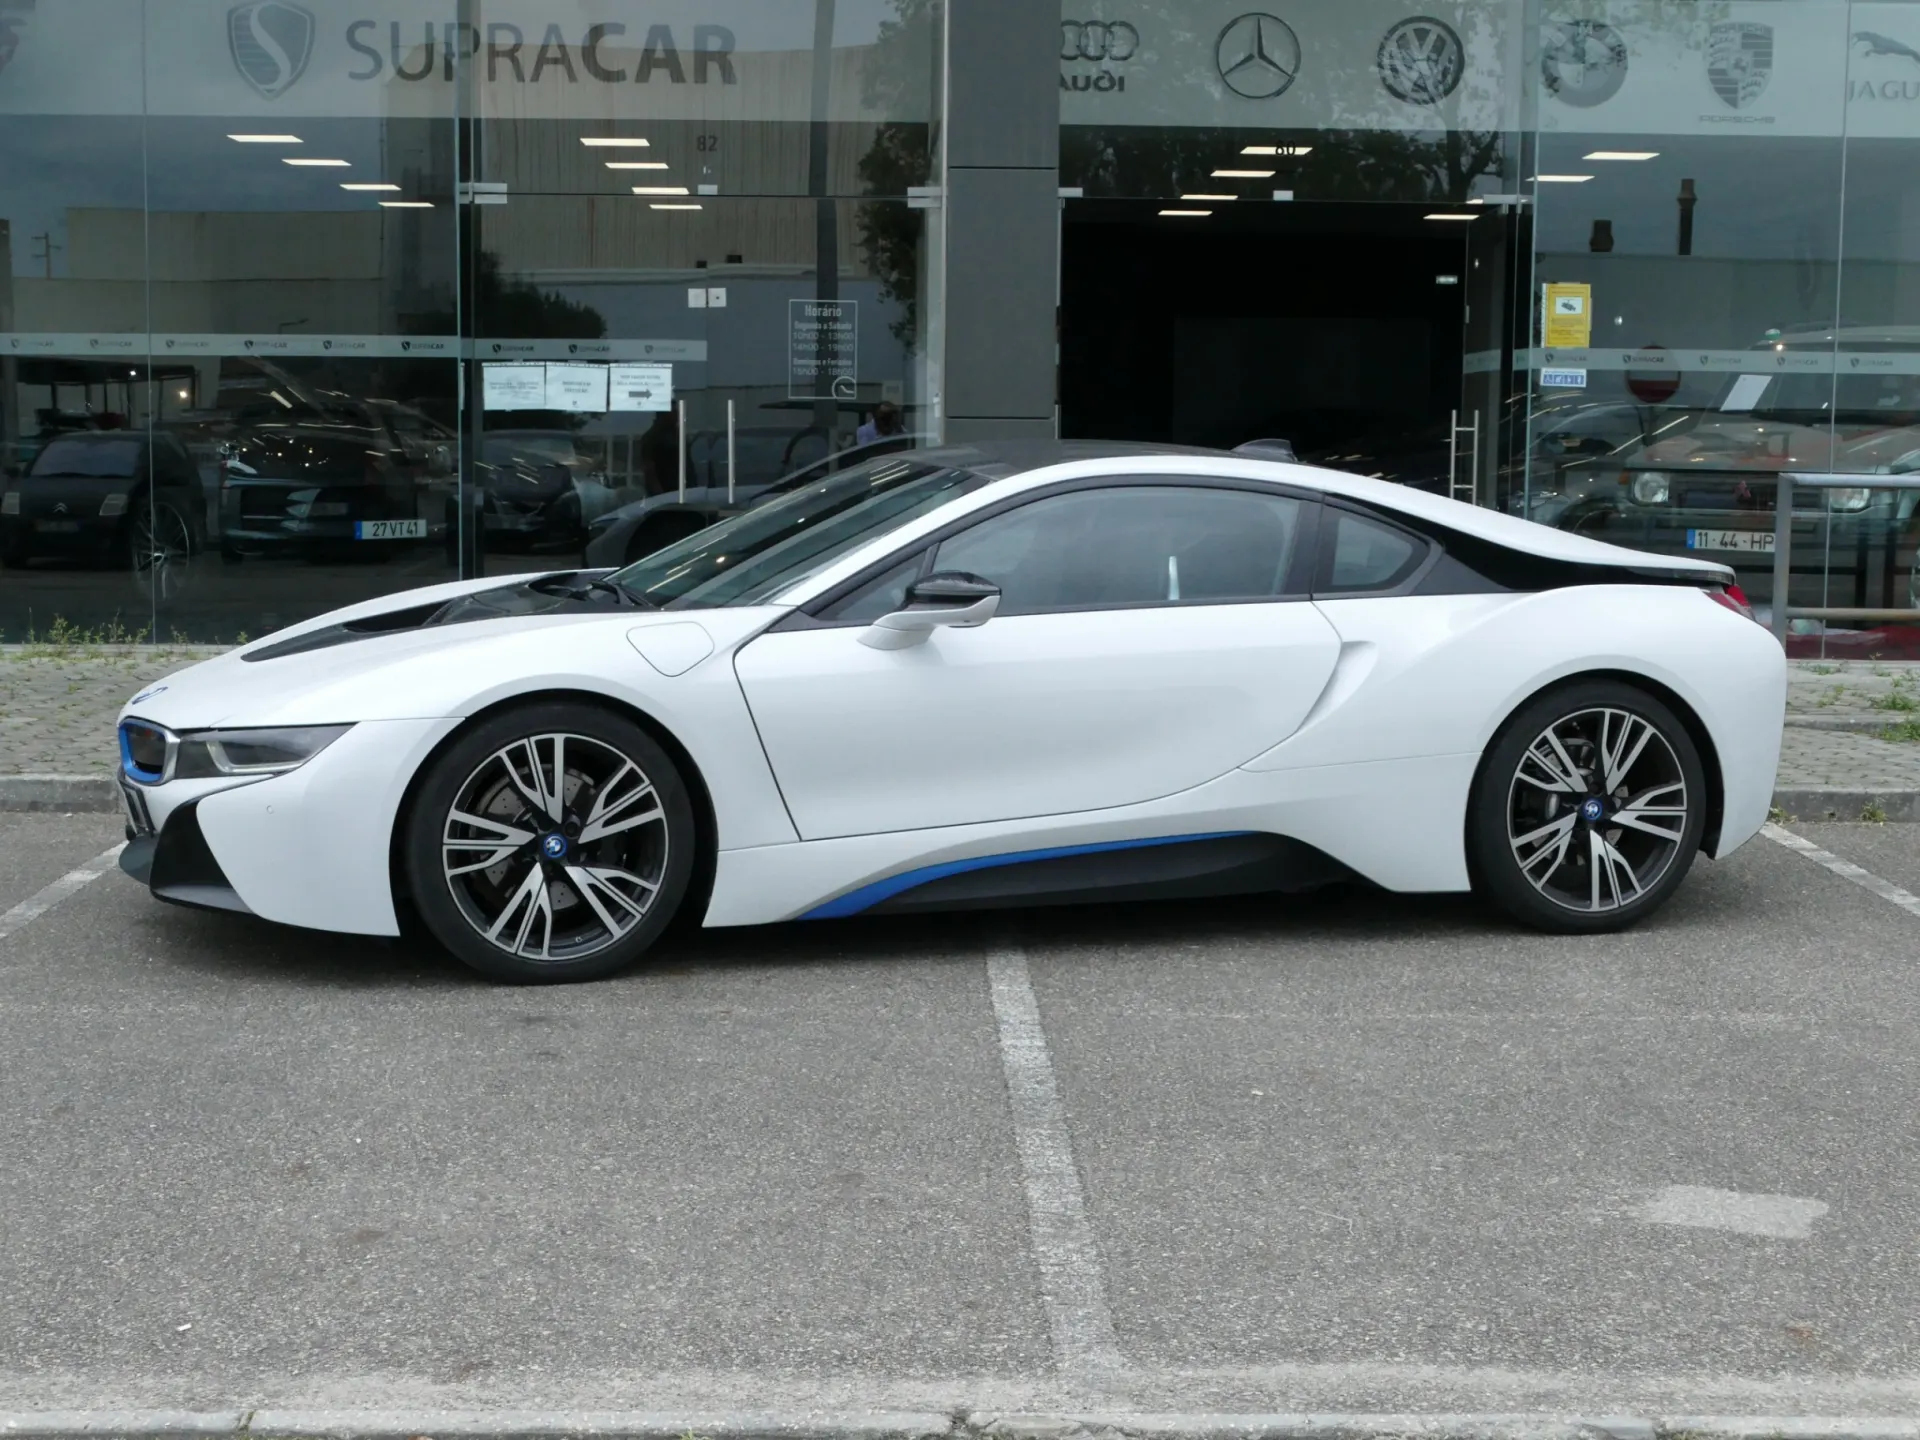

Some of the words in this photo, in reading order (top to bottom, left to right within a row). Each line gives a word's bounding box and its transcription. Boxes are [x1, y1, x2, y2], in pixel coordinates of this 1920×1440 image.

[345, 19, 738, 85] SUPRACAR
[1699, 114, 1776, 124] PORSCHE
[696, 135, 719, 152] 82
[1274, 140, 1297, 157] 80
[804, 304, 842, 317] Horário
